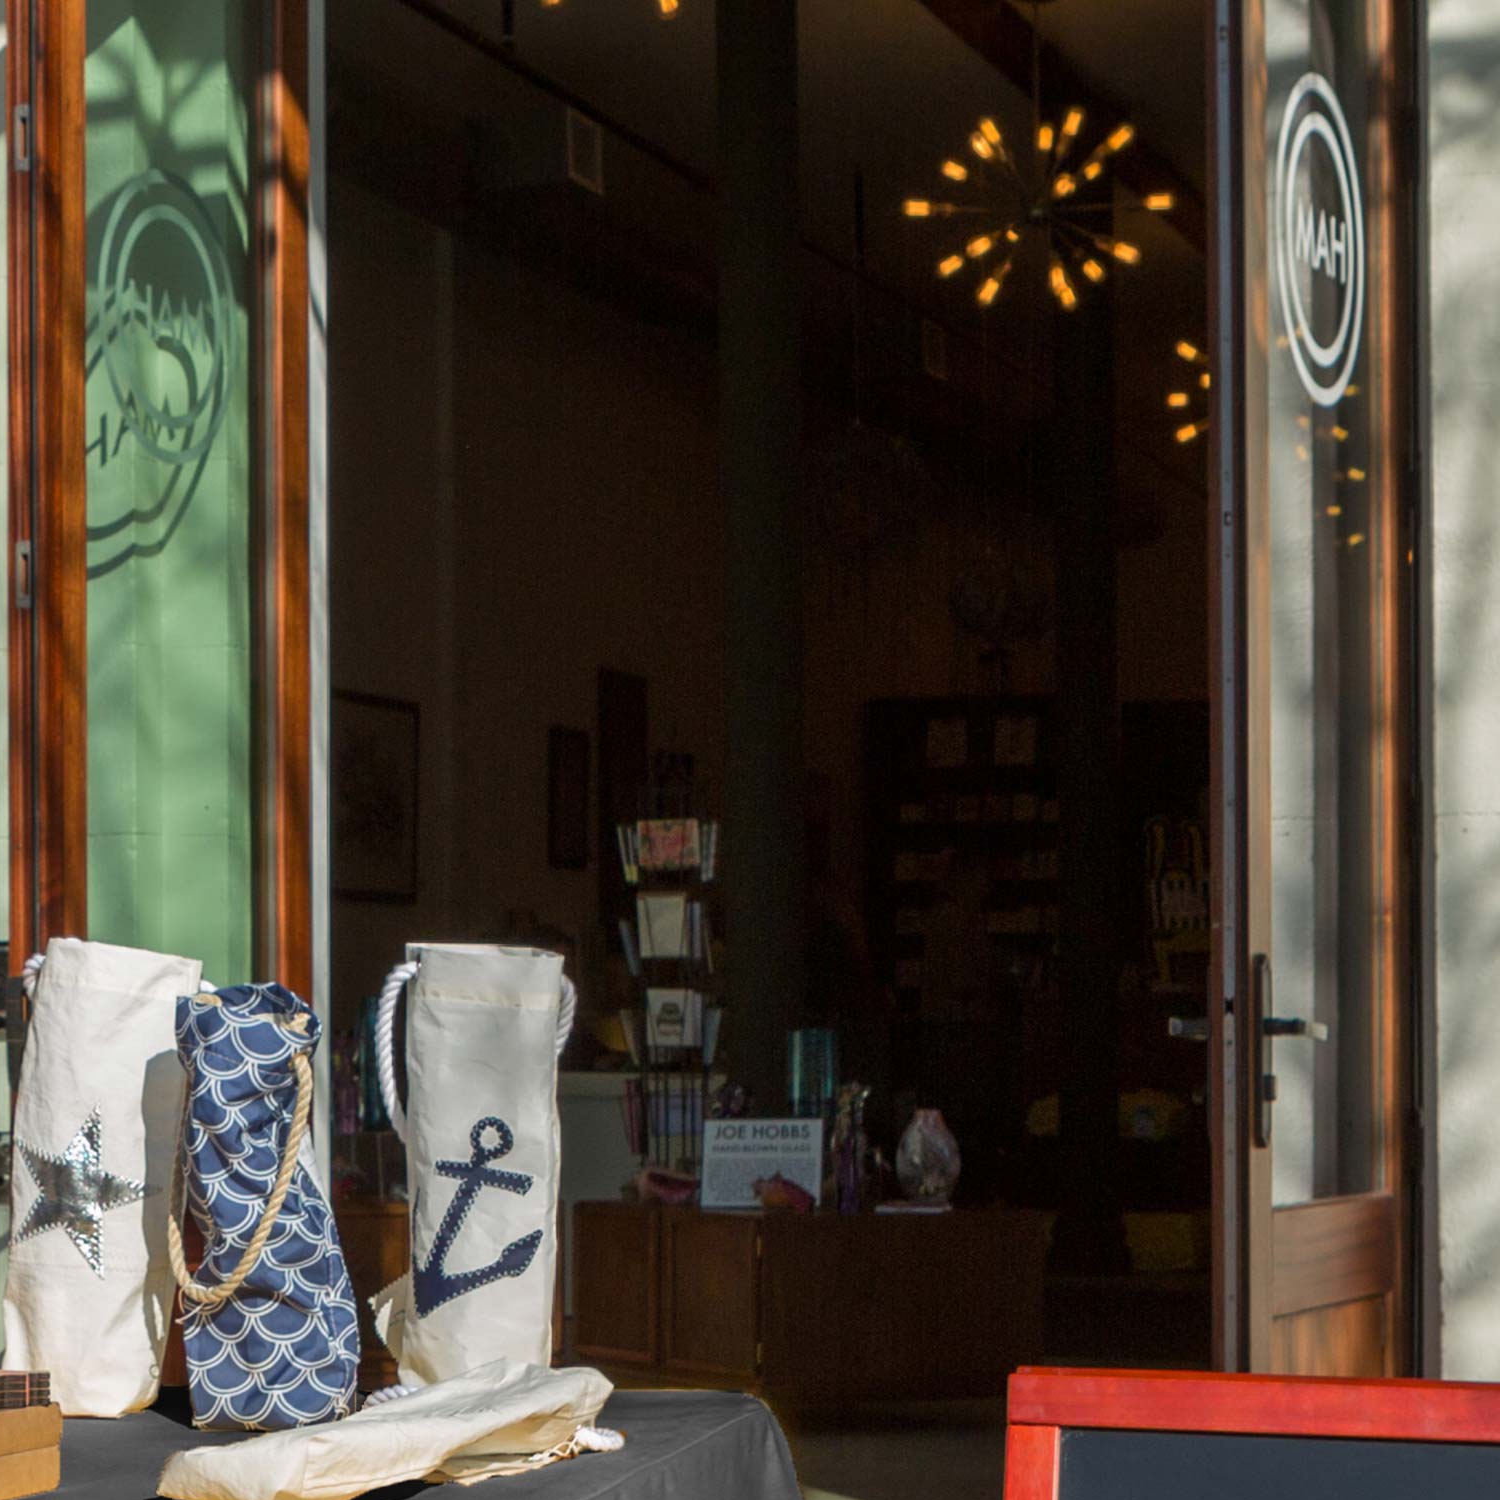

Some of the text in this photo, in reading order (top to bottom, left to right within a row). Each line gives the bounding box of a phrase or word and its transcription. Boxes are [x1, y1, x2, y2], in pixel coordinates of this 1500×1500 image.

[1296, 199, 1346, 284] MAH
[715, 1124, 811, 1140] JOE HOBBS
